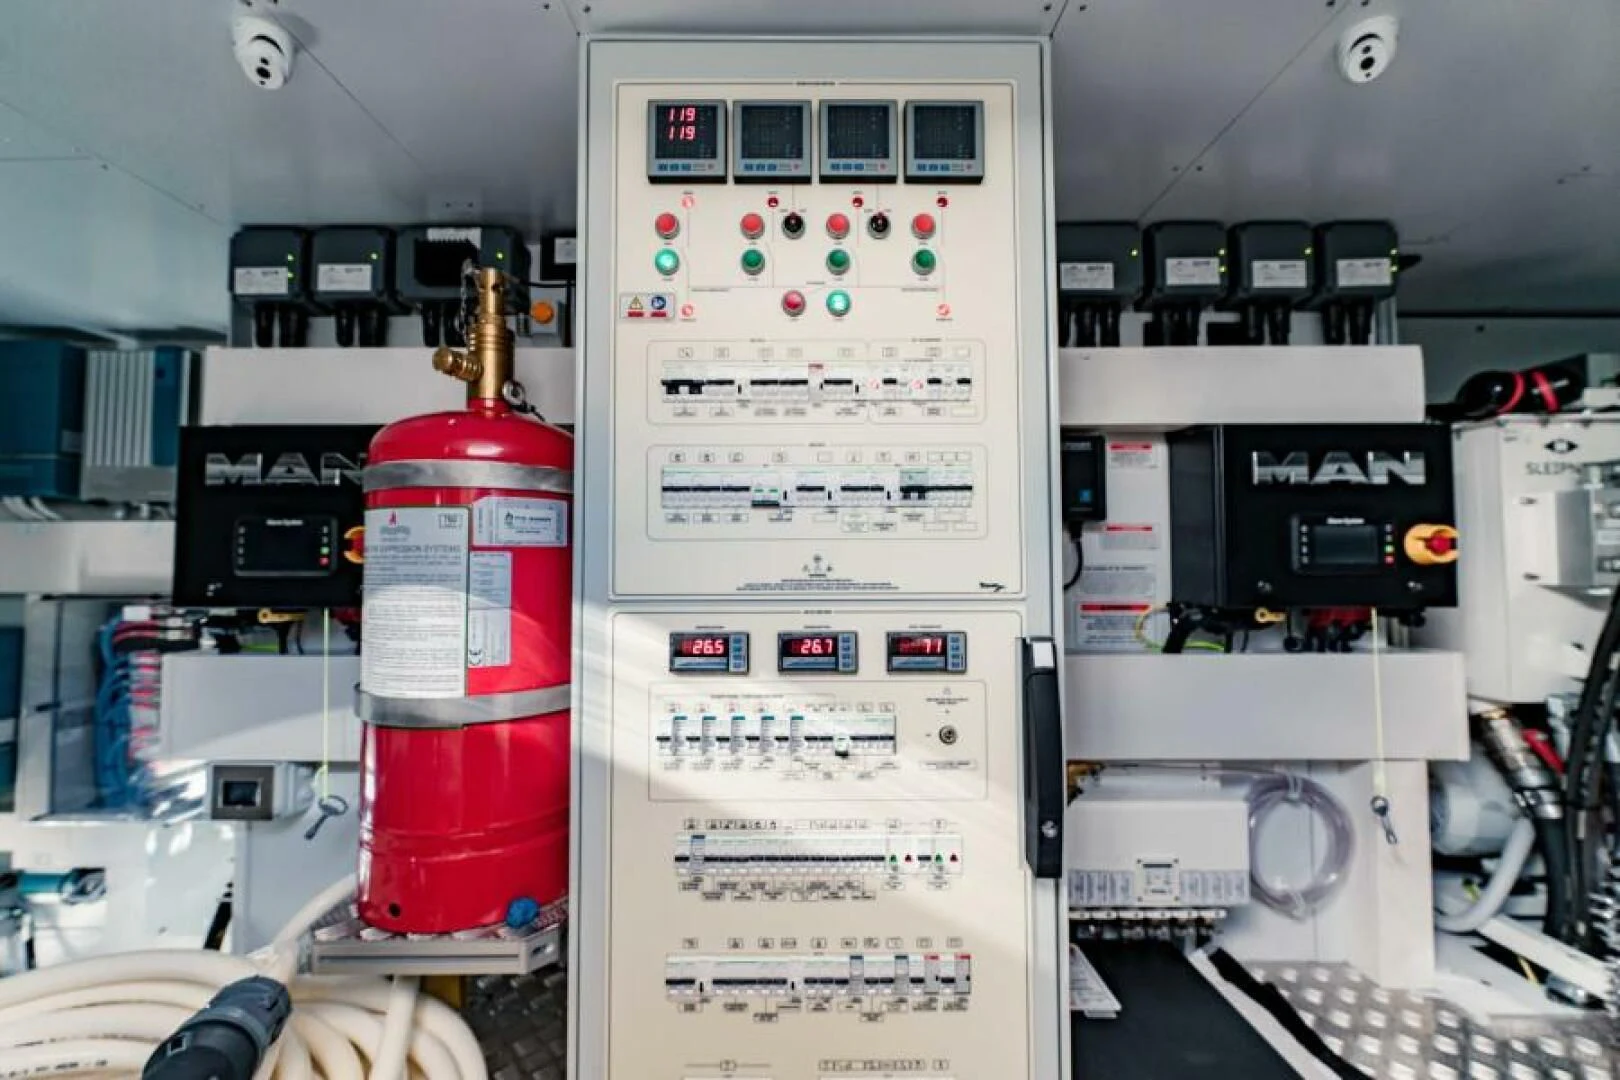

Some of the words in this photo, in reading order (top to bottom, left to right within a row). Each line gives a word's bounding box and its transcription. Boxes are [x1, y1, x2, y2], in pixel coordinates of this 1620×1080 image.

[668, 107, 696, 121] 119
[668, 126, 696, 140] 119
[204, 452, 368, 486] MAN
[1252, 450, 1427, 486] MAN
[692, 639, 725, 655] 26.5
[800, 639, 833, 654] 26.7
